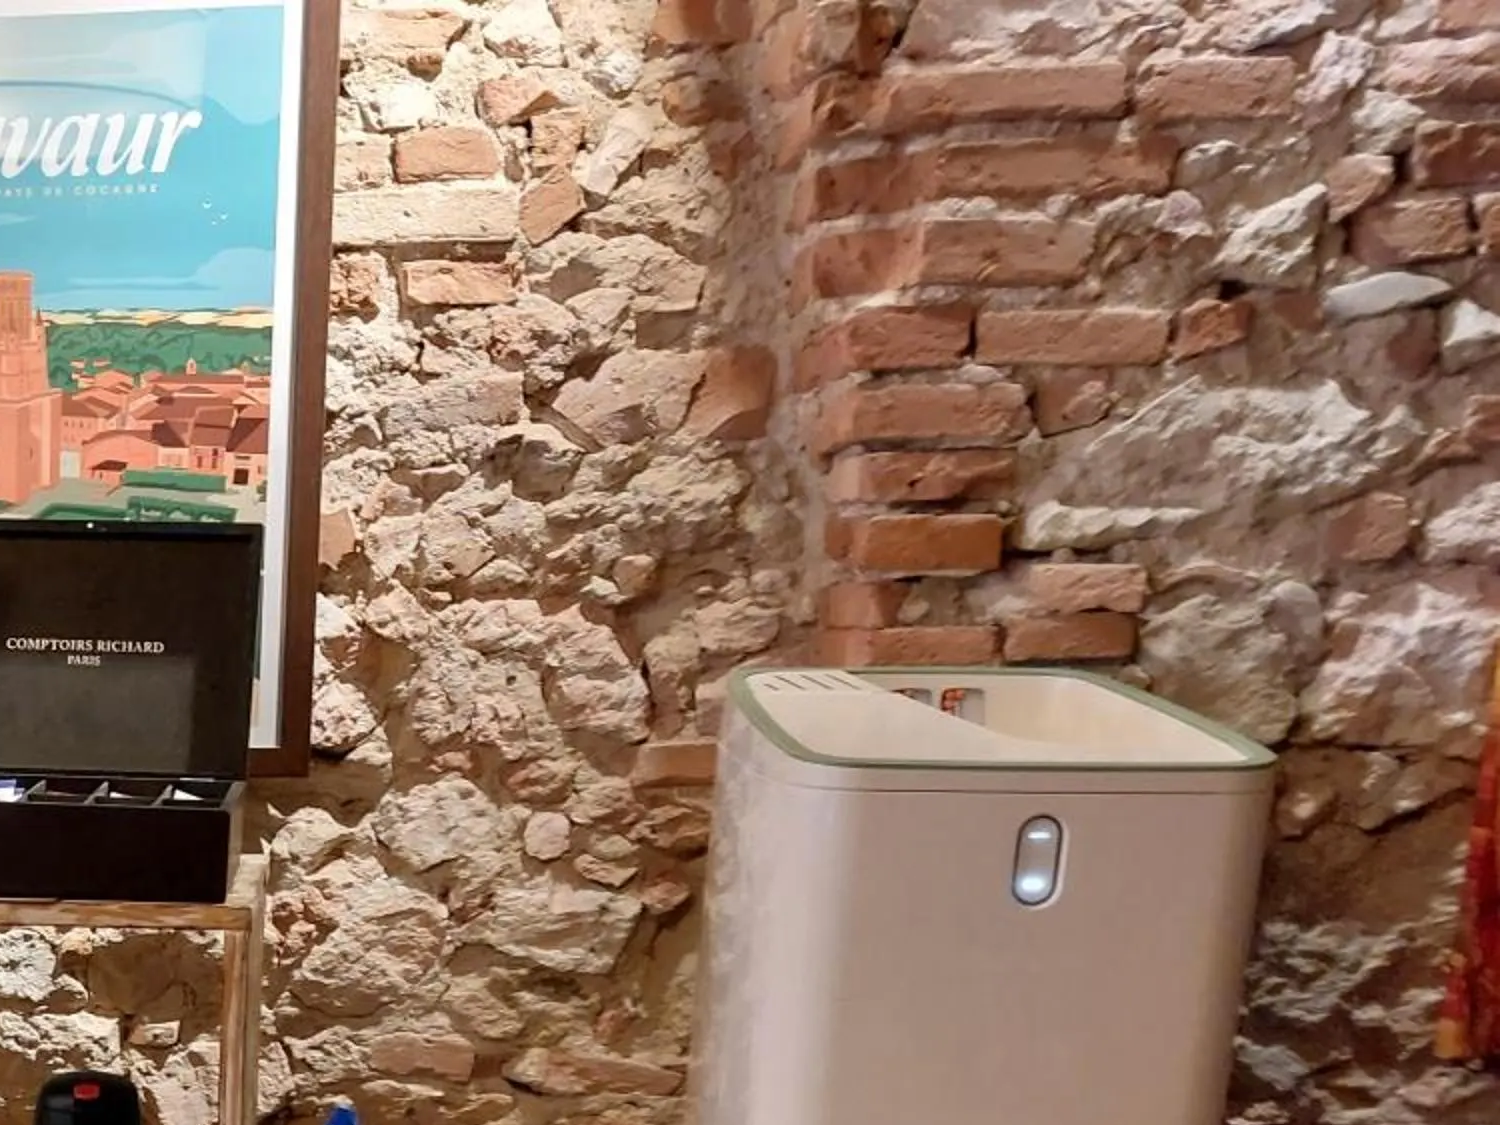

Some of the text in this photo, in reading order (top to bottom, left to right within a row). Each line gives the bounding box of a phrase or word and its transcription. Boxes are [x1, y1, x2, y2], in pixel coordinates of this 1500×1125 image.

[74, 183, 161, 196] COCAGNE
[5, 637, 165, 653] COMPTOIRS RICHARD
[67, 654, 101, 666] PARIS
